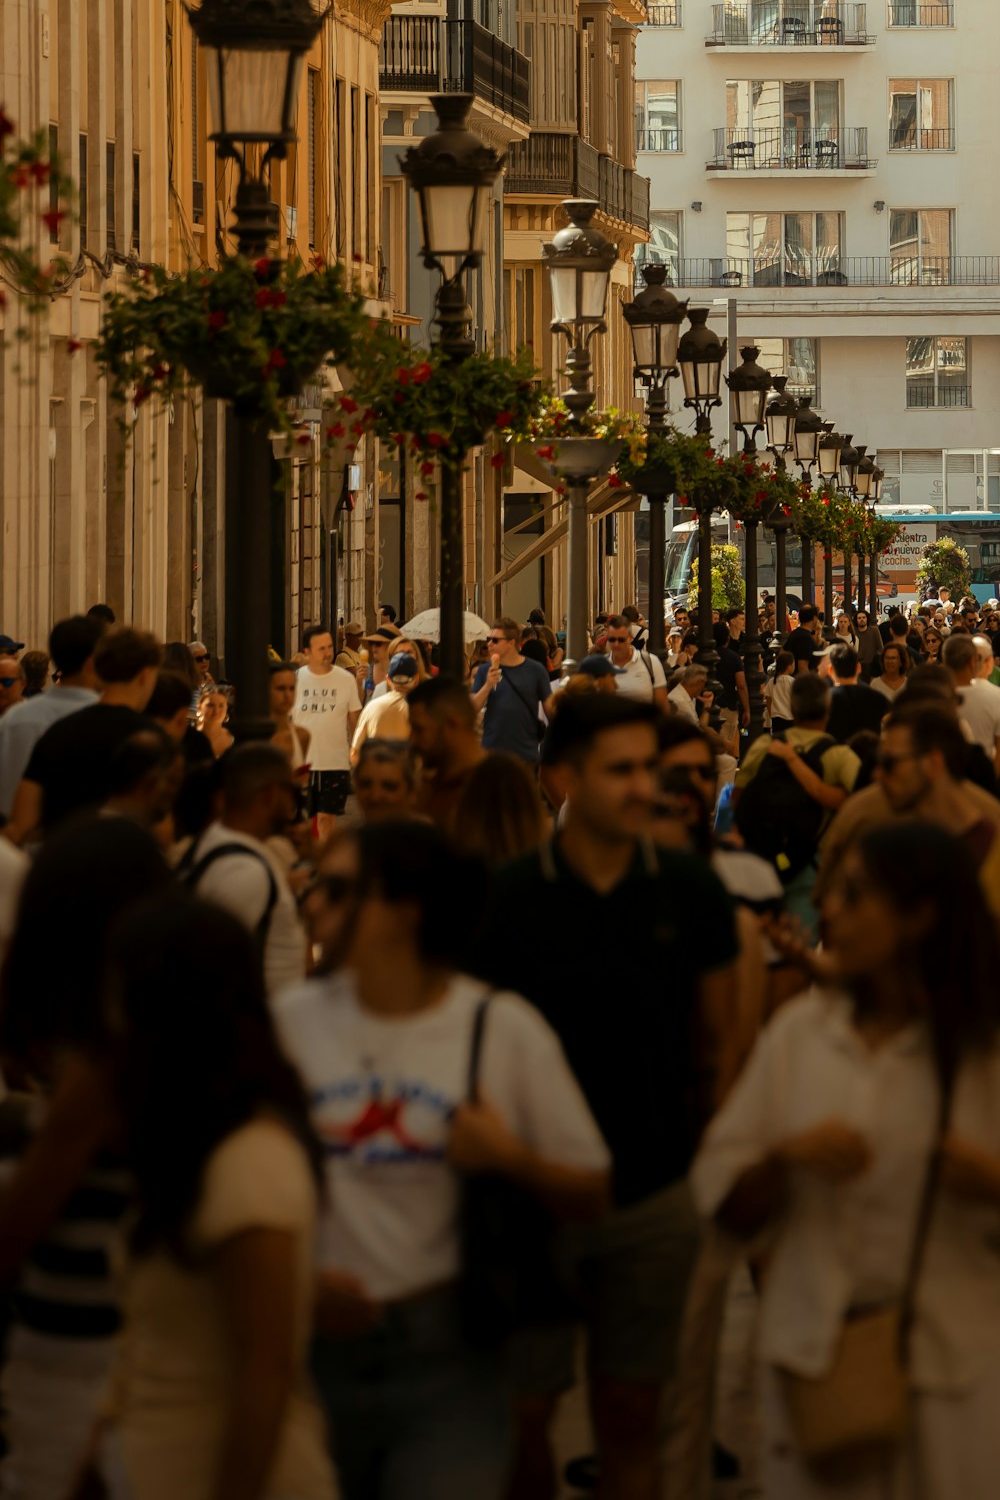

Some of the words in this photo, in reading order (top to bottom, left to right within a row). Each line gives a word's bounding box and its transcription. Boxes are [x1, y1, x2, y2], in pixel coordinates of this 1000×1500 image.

[892, 533, 928, 543] cuentra
[303, 688, 337, 697] BLUE
[301, 703, 336, 712] ONLY
